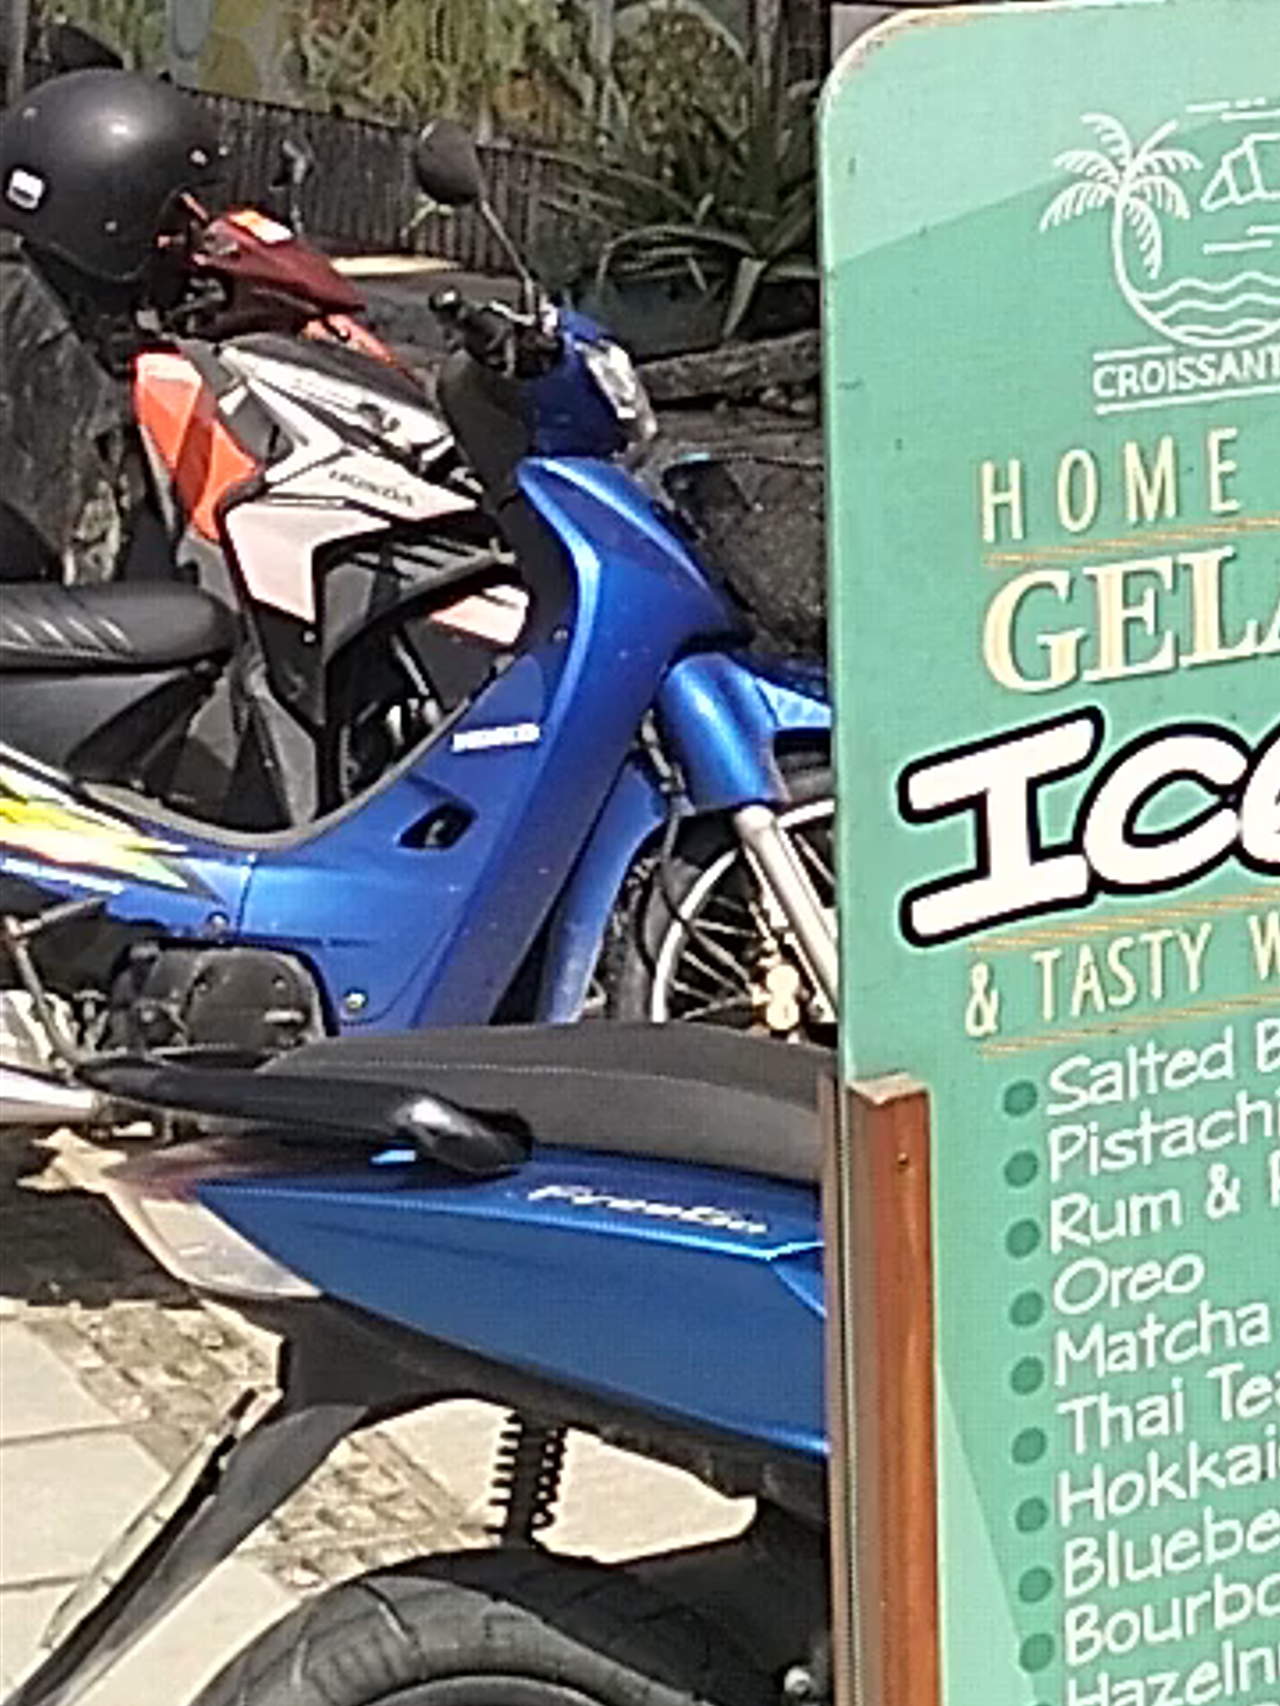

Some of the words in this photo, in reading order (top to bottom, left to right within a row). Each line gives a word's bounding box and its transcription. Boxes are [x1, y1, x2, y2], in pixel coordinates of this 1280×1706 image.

[979, 427, 1242, 543] HOME
[964, 964, 998, 1038] &
[1032, 924, 1210, 1022] TASTY
[1045, 1029, 1236, 1117] Salted
[1050, 1187, 1182, 1255] Rum
[1205, 1163, 1241, 1221] &
[1052, 1251, 1205, 1315] Oreo
[1054, 1294, 1272, 1386] Matcha
[1057, 1377, 1185, 1456] Thai
